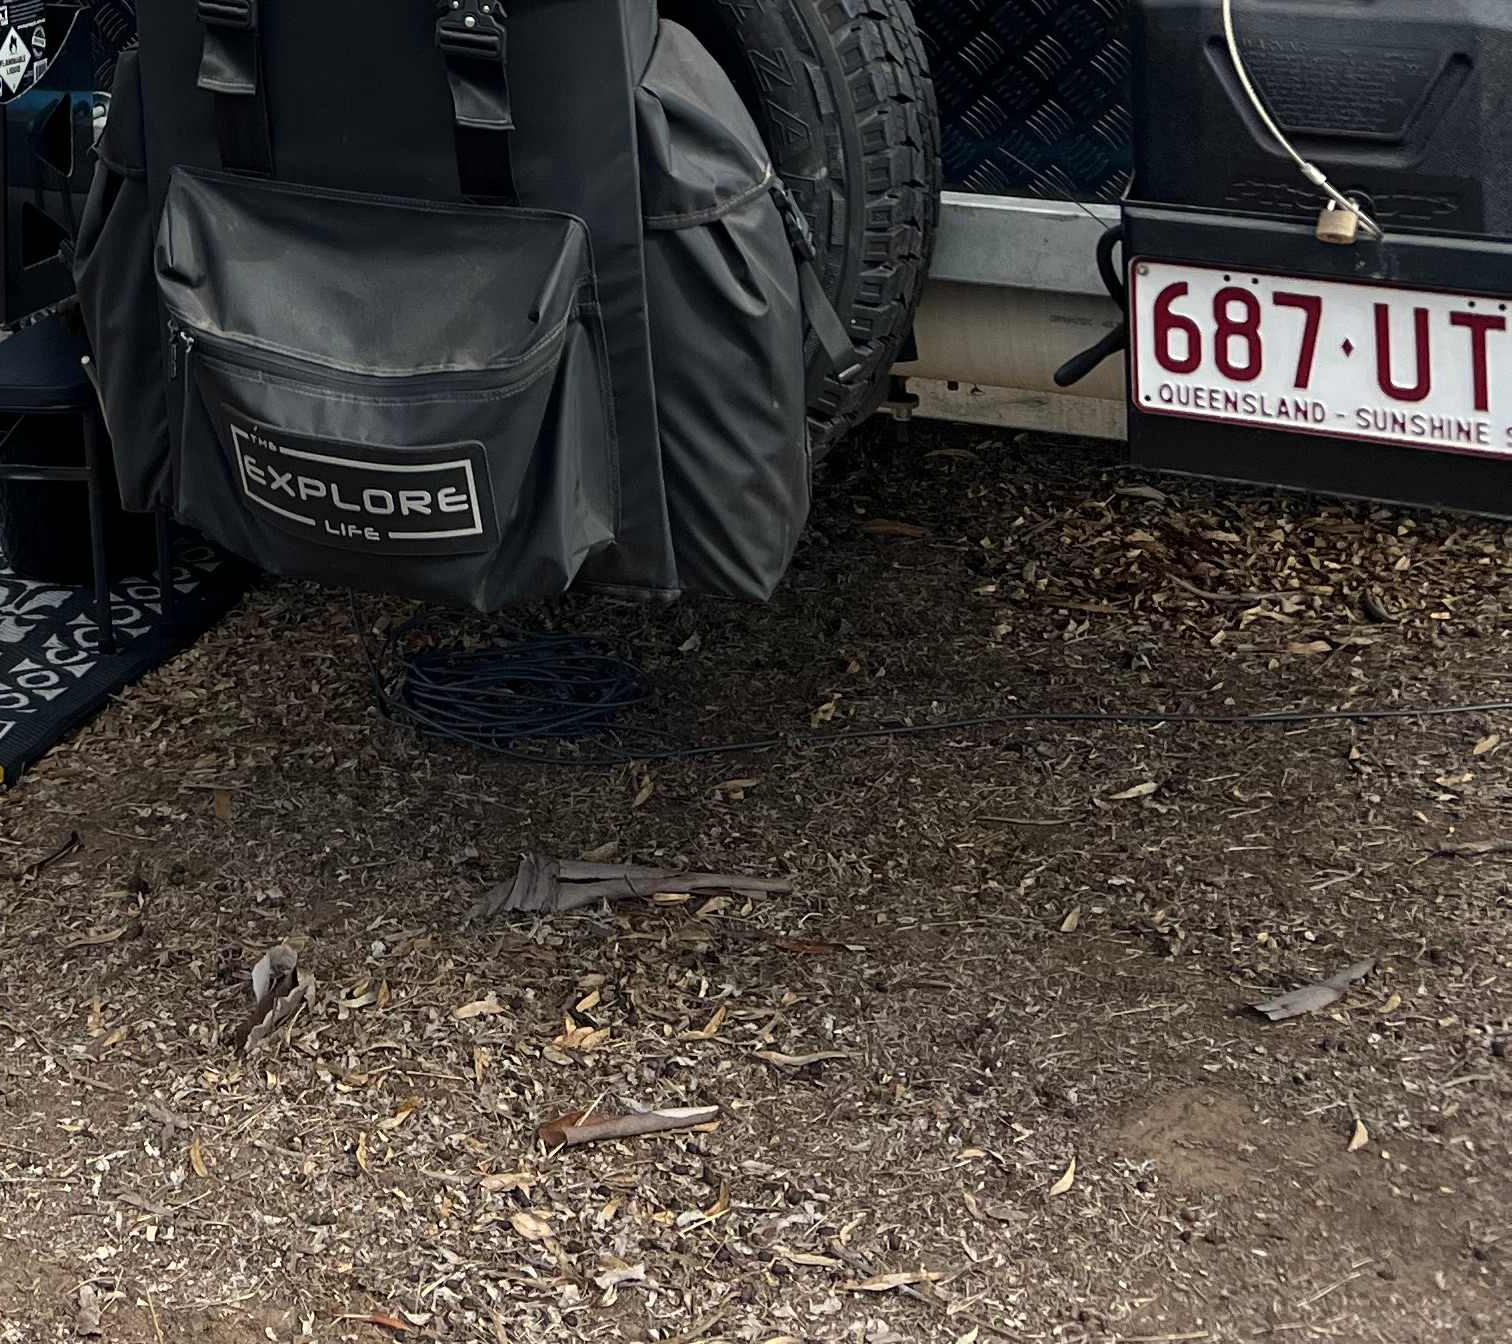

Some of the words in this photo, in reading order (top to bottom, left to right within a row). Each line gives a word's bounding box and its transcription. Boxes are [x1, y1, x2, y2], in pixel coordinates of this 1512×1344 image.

[1158, 382, 1326, 424] QUEENSLAND
[1355, 407, 1491, 446] SUNSHINE
[243, 454, 469, 516] EXPLORE
[324, 519, 381, 541] LIFE
